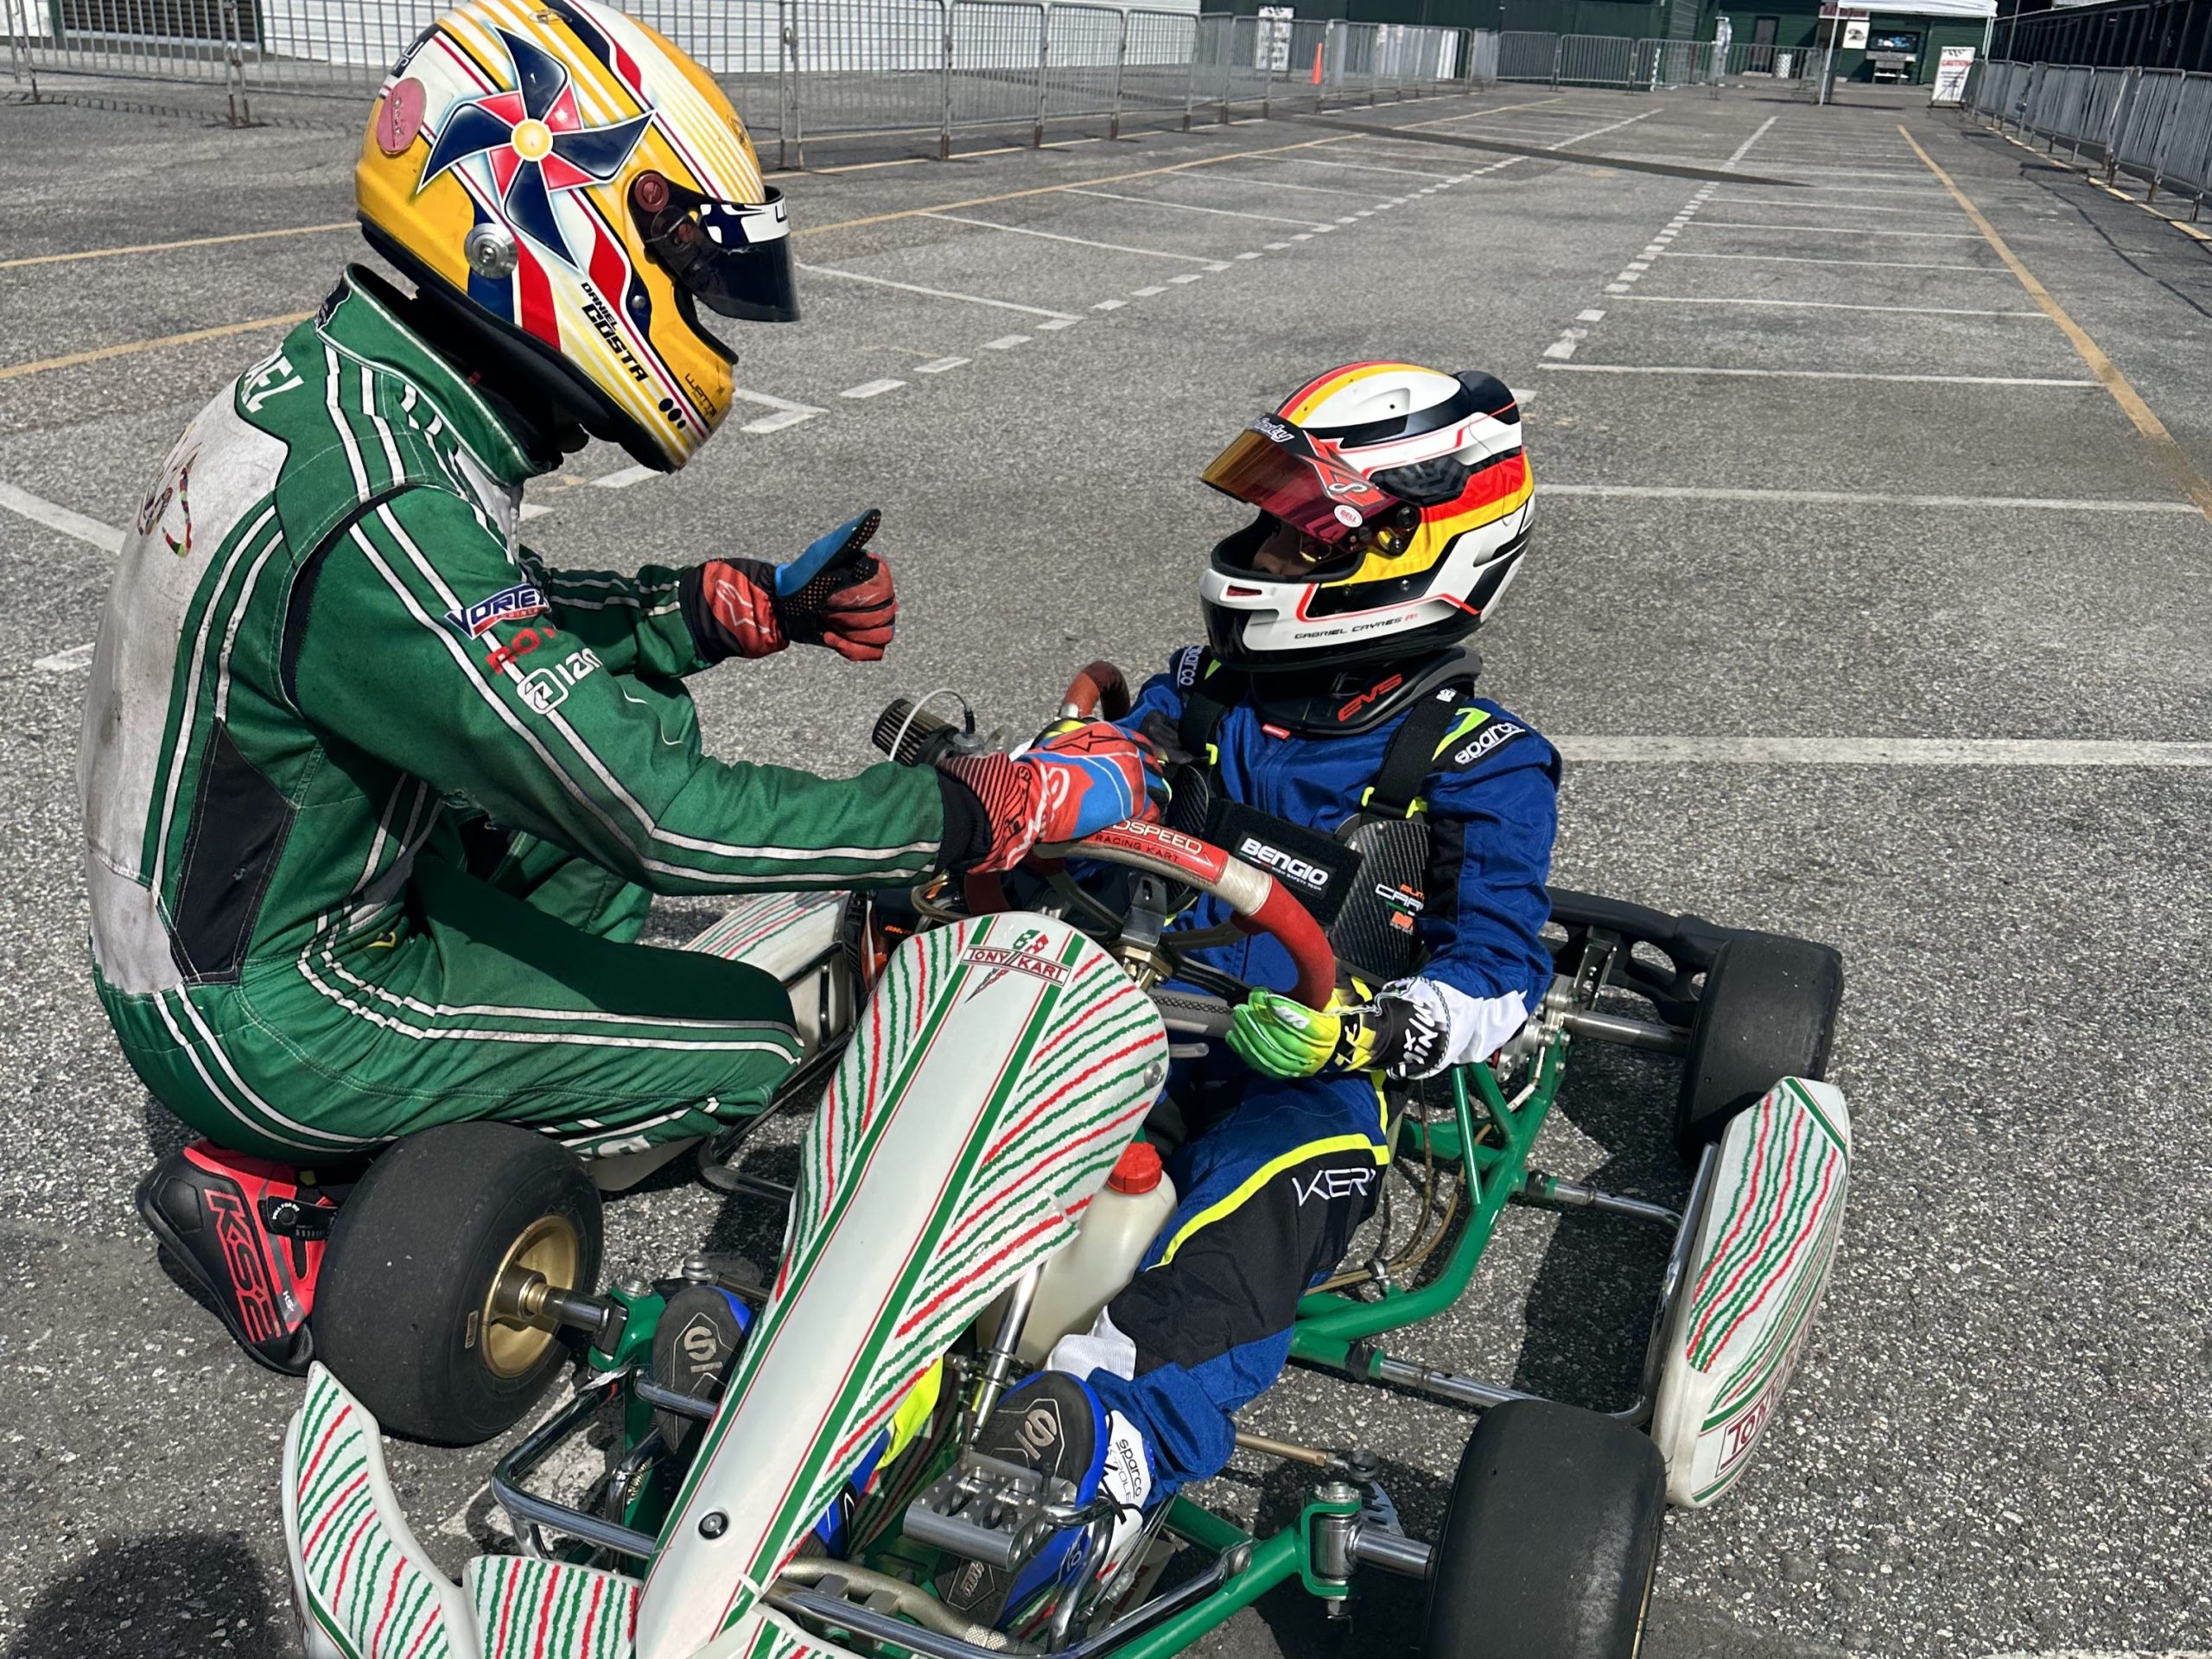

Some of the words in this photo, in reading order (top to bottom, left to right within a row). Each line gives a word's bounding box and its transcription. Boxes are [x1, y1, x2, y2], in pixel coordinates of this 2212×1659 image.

[581, 282, 618, 331] DANIEL
[582, 303, 649, 382] COSTA
[1340, 509, 1357, 523] BELL
[486, 627, 556, 675] RO
[1294, 628, 1348, 639] GABRIEL
[1351, 617, 1403, 632] CAYRES
[1338, 674, 1402, 721] EVS
[1095, 834, 1142, 851] RACING
[1147, 845, 1180, 862] KART
[1241, 837, 1329, 886] BENGIO
[1375, 883, 1424, 912] CAR
[969, 947, 1012, 963] TONY
[1018, 954, 1069, 980] KART
[1116, 1439, 1142, 1498] sparco
